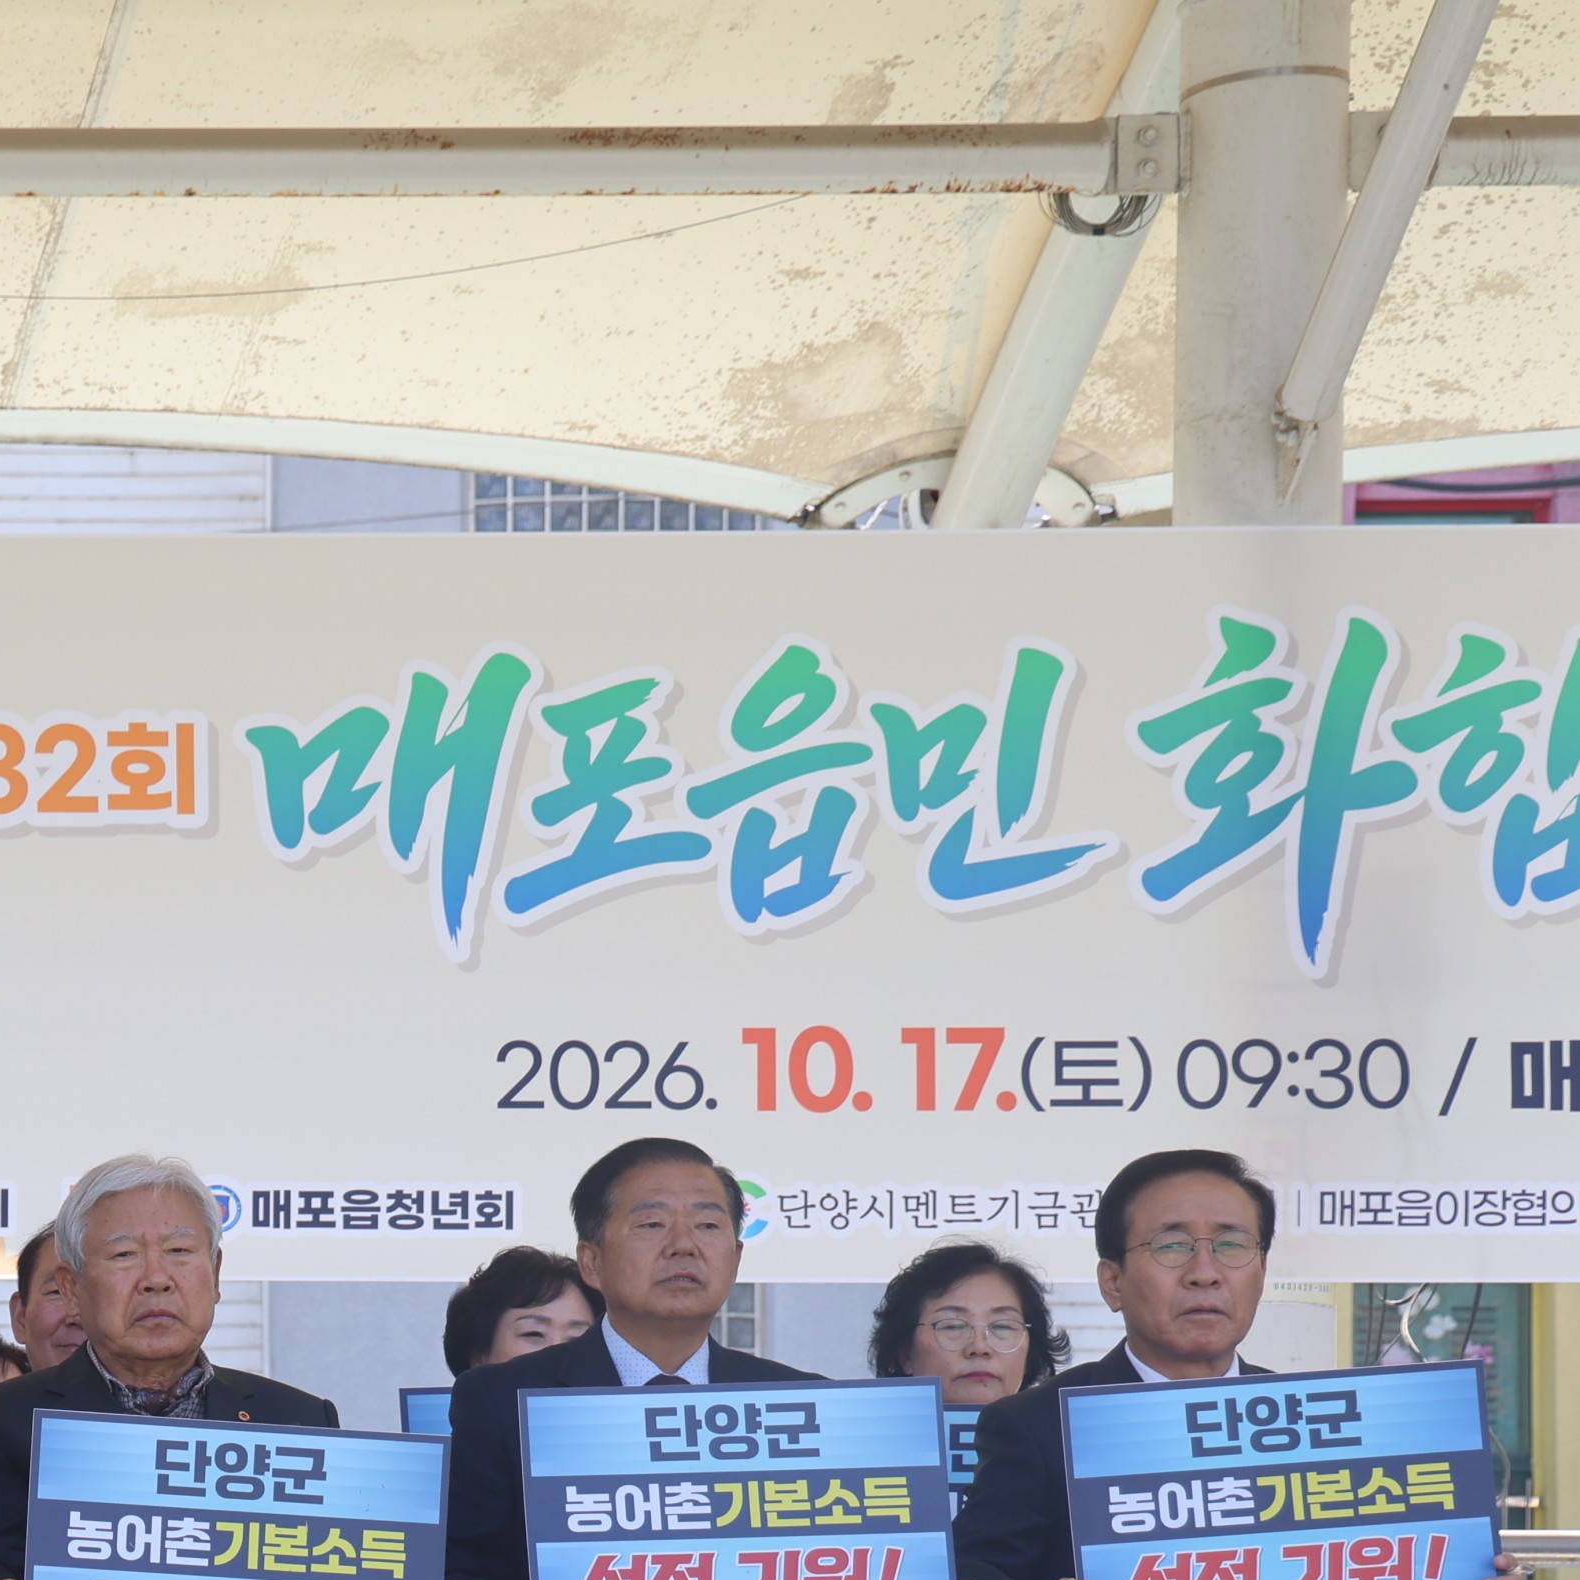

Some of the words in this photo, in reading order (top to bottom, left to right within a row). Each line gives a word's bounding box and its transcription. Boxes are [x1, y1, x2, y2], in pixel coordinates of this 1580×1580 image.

[244, 644, 1109, 948] 매포읍민
[496, 1040, 719, 1112] 2026.
[742, 1025, 873, 1113] 10.
[1176, 1038, 1411, 1111] 09:30
[1438, 1037, 1478, 1116] /
[251, 1189, 514, 1230] 매포읍청년회
[645, 1402, 821, 1462] 단양군
[1185, 1390, 1362, 1458] 단양군
[155, 1439, 327, 1505] 단양군
